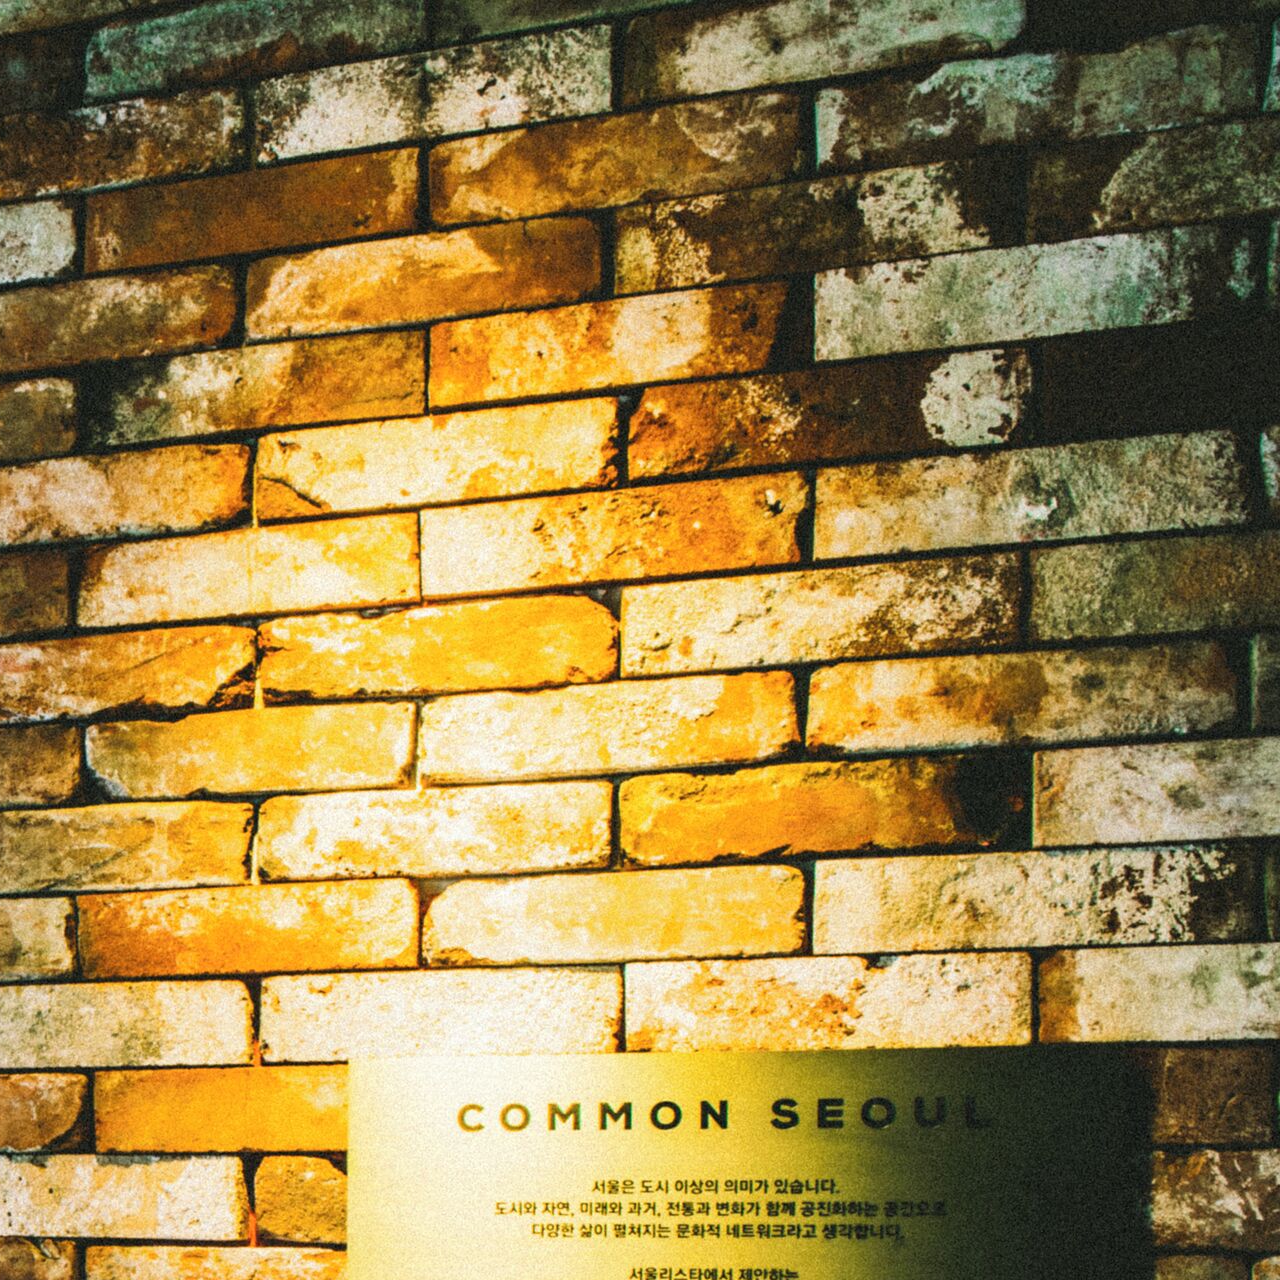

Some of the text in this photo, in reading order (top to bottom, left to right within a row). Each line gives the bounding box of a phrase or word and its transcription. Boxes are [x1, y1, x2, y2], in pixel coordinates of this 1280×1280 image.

[456, 1096, 993, 1132] COMMON SEOUL
[591, 1178, 840, 1195] 서울은 도시 이상의 의미가 있습니다.
[494, 1201, 537, 1216] 도시와
[541, 1201, 575, 1218] 자연,
[579, 1201, 623, 1216] 미래와
[627, 1201, 662, 1218] 과거,
[666, 1201, 711, 1217] 전통과
[715, 1201, 761, 1217] 변화가
[766, 1201, 796, 1217] 함께
[800, 1201, 879, 1217] 공진화하는
[531, 1223, 906, 1240] 다양한 삶이 펼쳐지는 문화적 네트워크라고 생각합니다.
